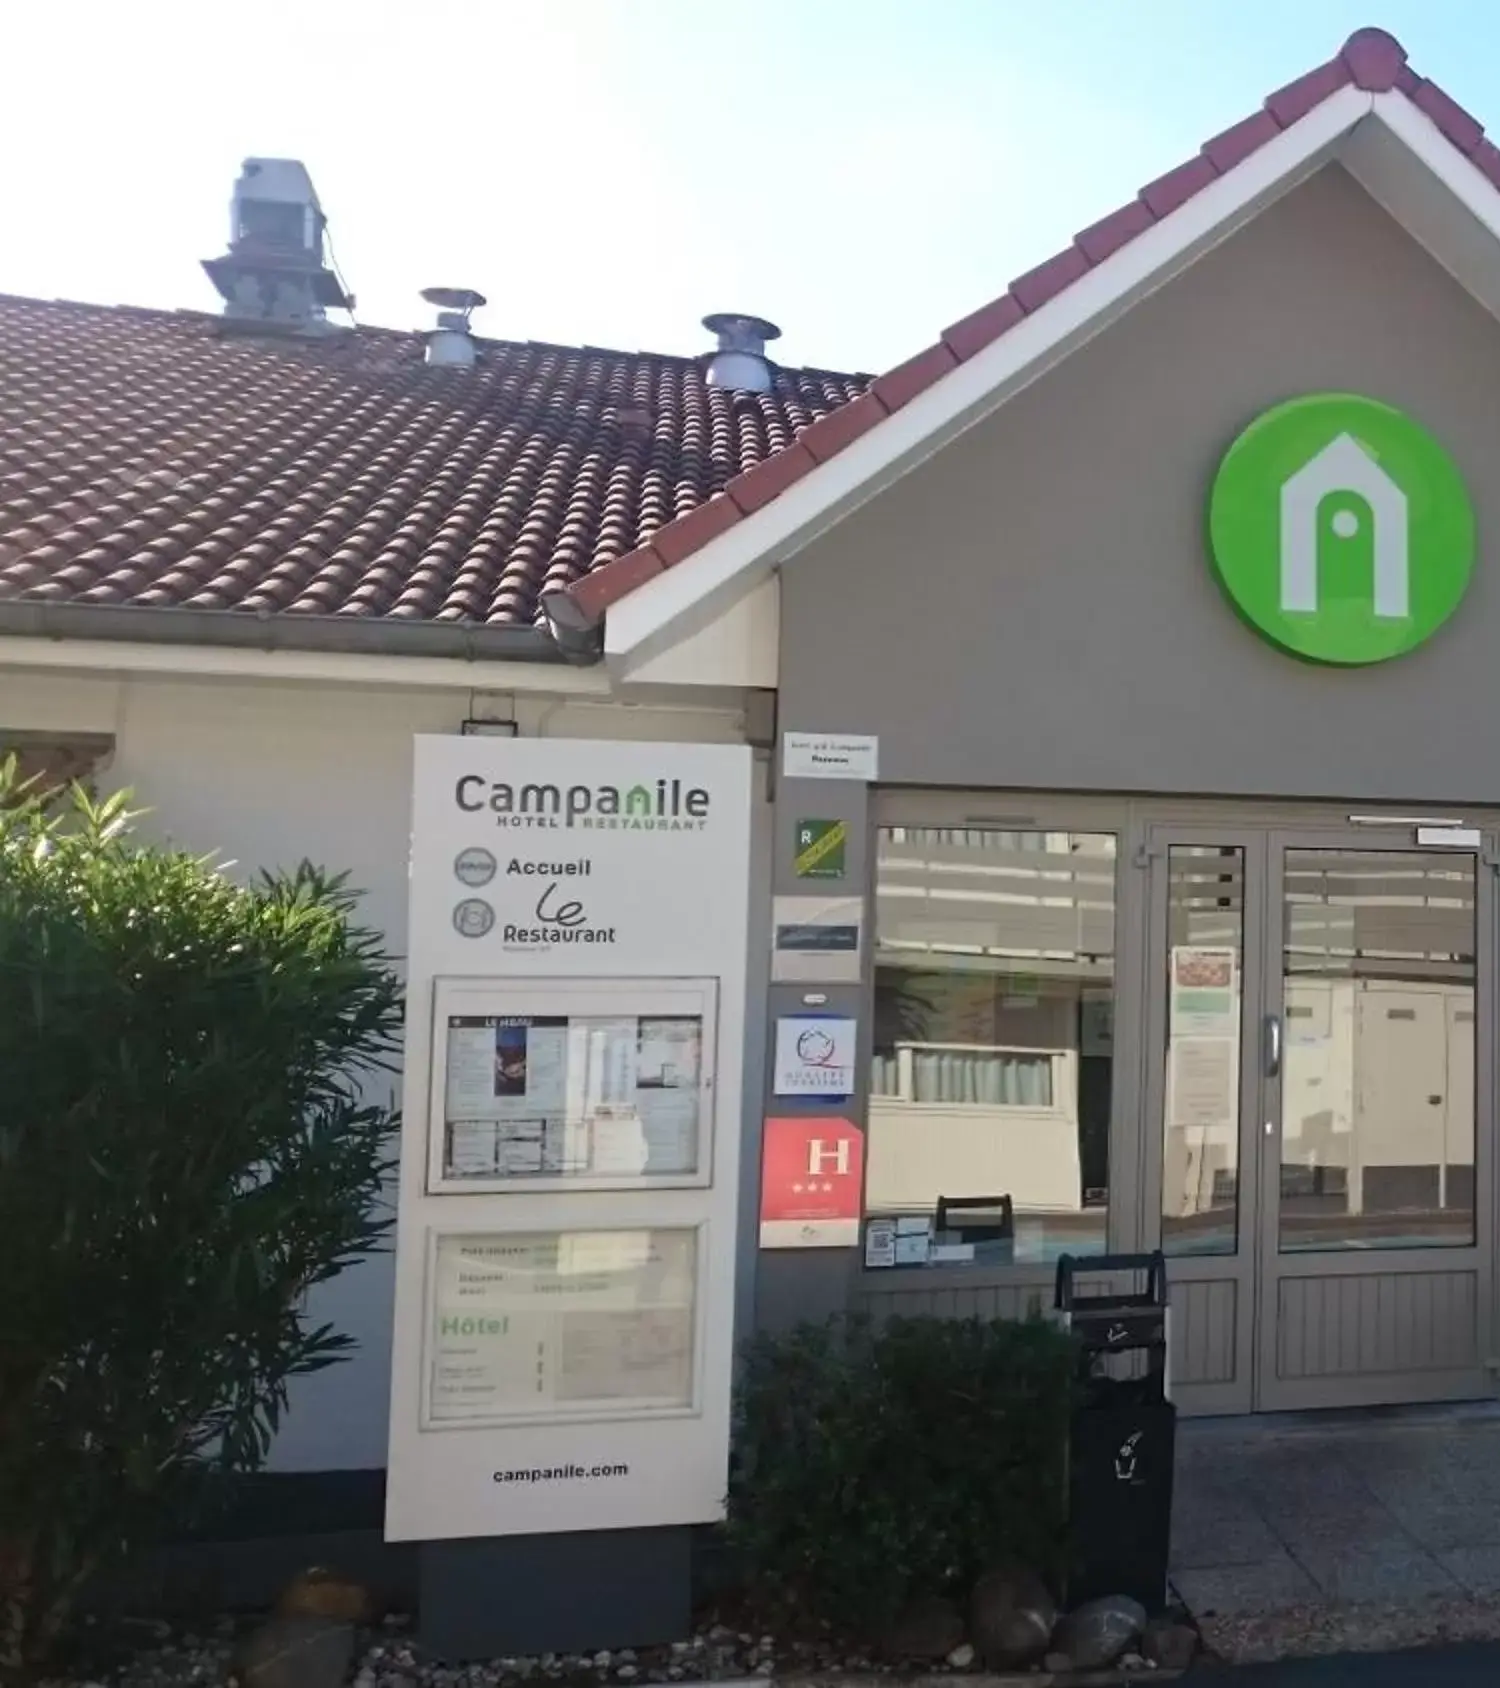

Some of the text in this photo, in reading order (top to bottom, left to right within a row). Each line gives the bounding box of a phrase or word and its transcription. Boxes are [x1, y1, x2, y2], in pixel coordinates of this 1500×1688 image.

[455, 775, 710, 828] Campanile
[496, 815, 707, 832] HOTEL RESTAURANT
[506, 858, 591, 876] Accueil
[535, 882, 587, 927] Le
[502, 925, 616, 943] Restaurant
[806, 1138, 853, 1176] H
[440, 1315, 510, 1337] Hôtel
[492, 1461, 630, 1484] campanile.com
